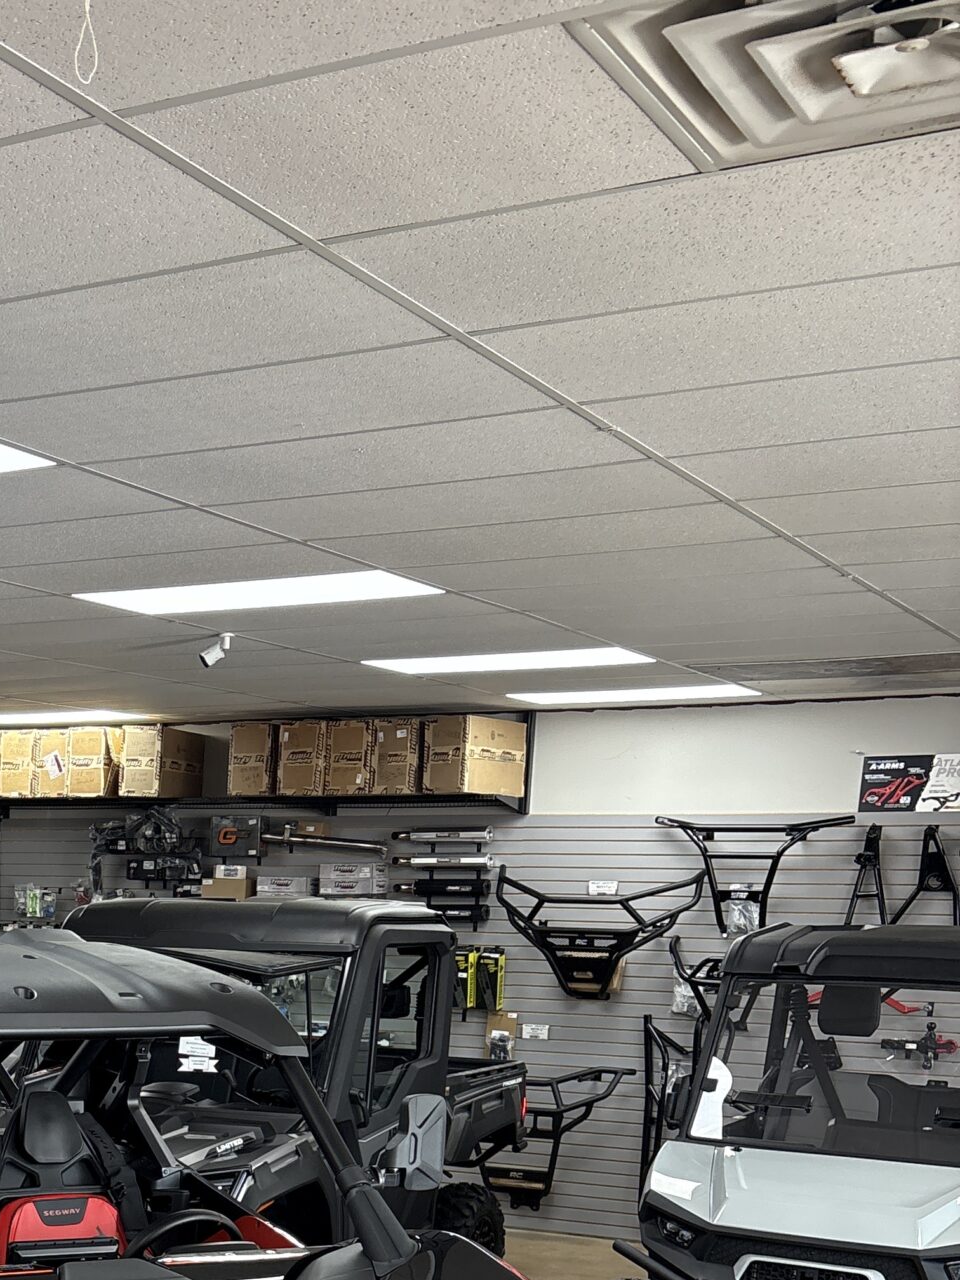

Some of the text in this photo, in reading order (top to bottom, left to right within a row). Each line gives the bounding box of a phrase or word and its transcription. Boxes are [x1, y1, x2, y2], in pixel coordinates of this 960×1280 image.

[869, 762, 906, 771] A-ARMS
[574, 938, 589, 947] RC
[216, 1138, 244, 1153] LIMITED
[43, 1207, 81, 1217] SEGWAY
